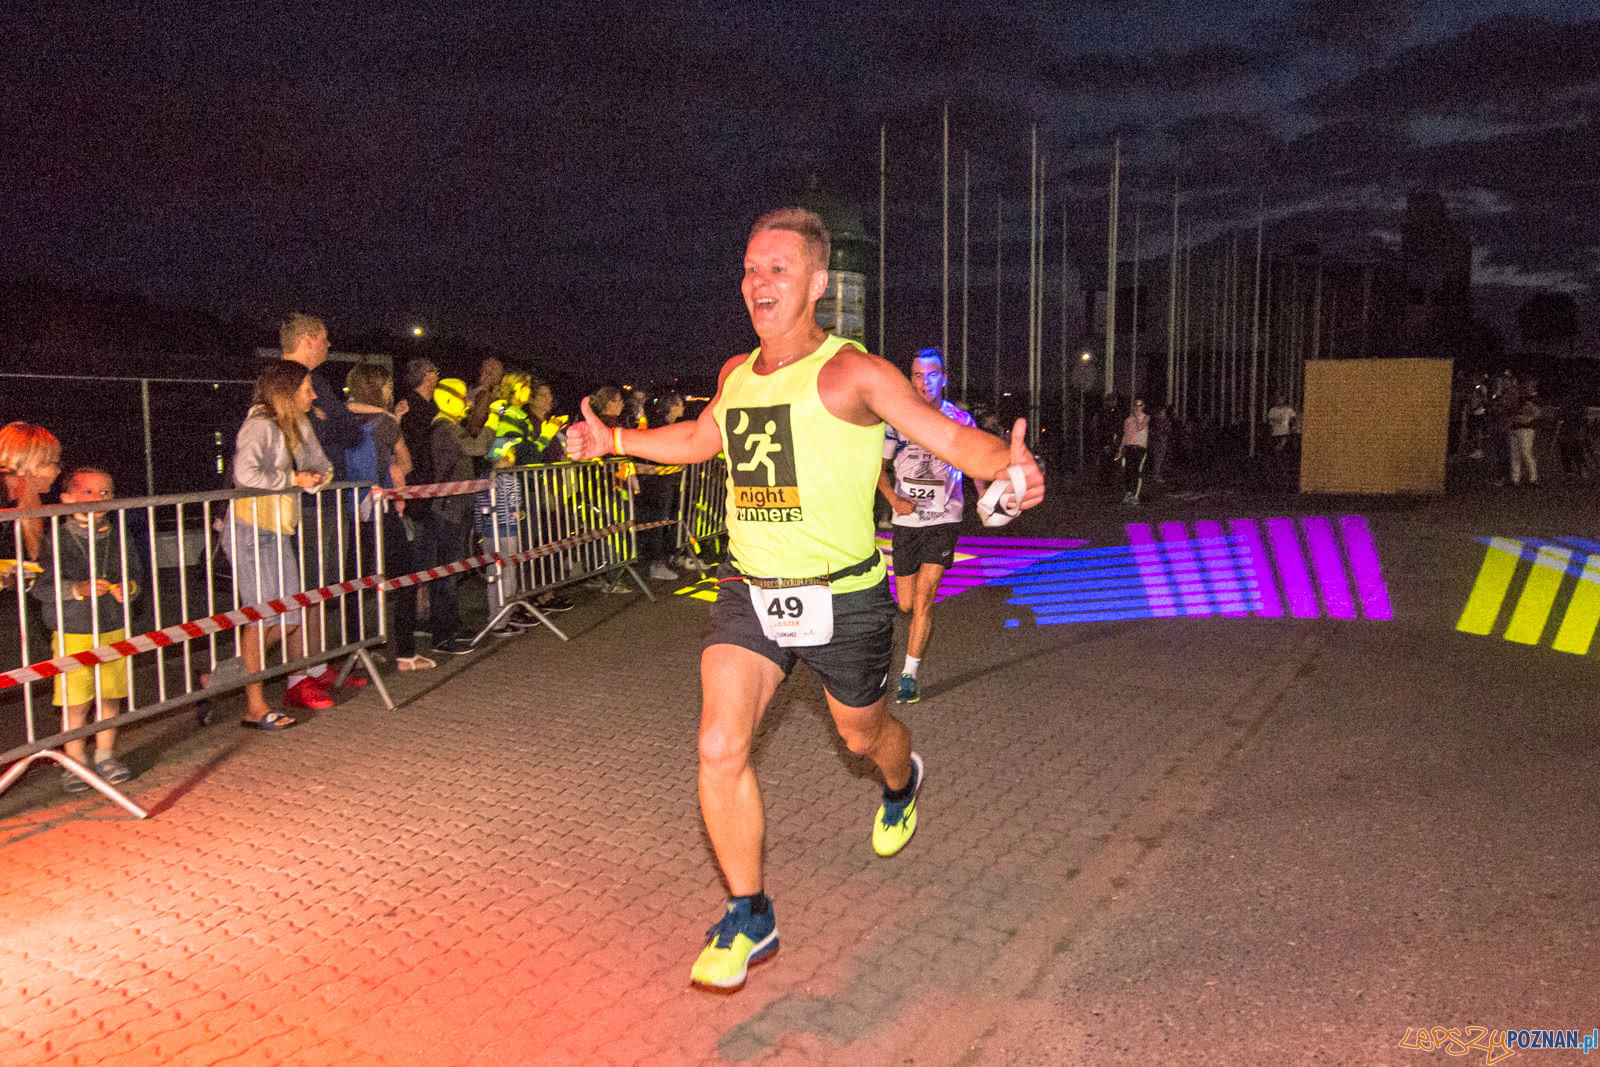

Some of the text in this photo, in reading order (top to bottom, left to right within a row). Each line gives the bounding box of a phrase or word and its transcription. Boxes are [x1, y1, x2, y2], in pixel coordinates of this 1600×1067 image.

[740, 487, 786, 507] night
[909, 487, 935, 500] 524
[767, 596, 804, 619] 49
